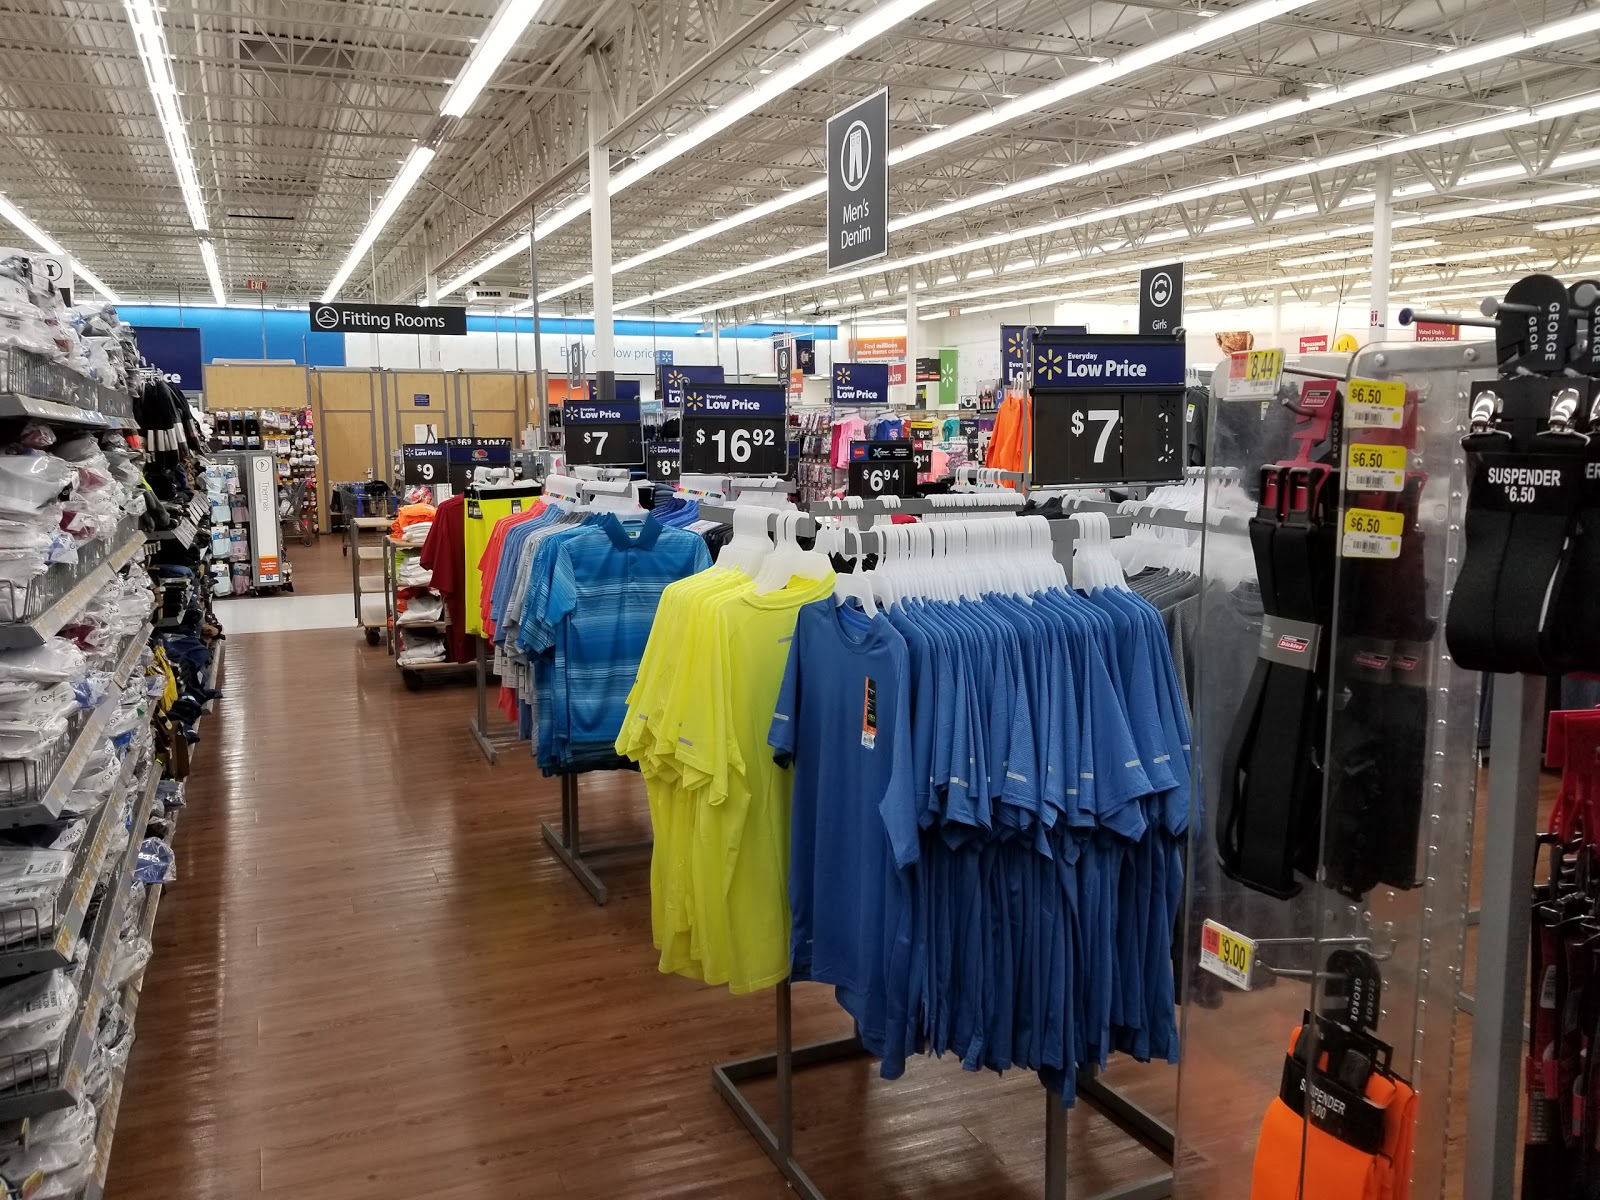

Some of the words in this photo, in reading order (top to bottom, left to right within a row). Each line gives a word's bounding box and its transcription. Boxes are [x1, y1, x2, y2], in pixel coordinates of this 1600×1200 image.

[843, 198, 869, 224] Men's
[841, 225, 871, 249] Denim
[251, 280, 264, 289] EXIT
[342, 311, 391, 330] Fitting
[395, 312, 446, 328] Rooms
[1152, 319, 1168, 331] Girls
[1529, 316, 1538, 352] GEOR
[1545, 302, 1560, 361] GEORGE
[613, 347, 632, 358] low
[1068, 353, 1098, 362] Everyday
[1067, 361, 1102, 377] Low
[1106, 360, 1147, 377] Price
[837, 390, 857, 399] Low
[856, 390, 878, 399] Price
[1352, 388, 1382, 404] $6.50
[706, 400, 730, 410] Low
[732, 399, 760, 410] Price
[580, 411, 599, 419] Low
[599, 411, 621, 419] Price
[583, 431, 609, 456] $7
[1071, 410, 1120, 464] $7
[1353, 452, 1383, 468] $6.50
[417, 463, 434, 480] $9
[1488, 467, 1561, 487] SUSPENDER
[1504, 486, 1536, 503] $6.50
[1351, 516, 1380, 533] $6.50
[1351, 978, 1362, 1022] GEORGE
[1300, 1078, 1346, 1116] SSPENDER
